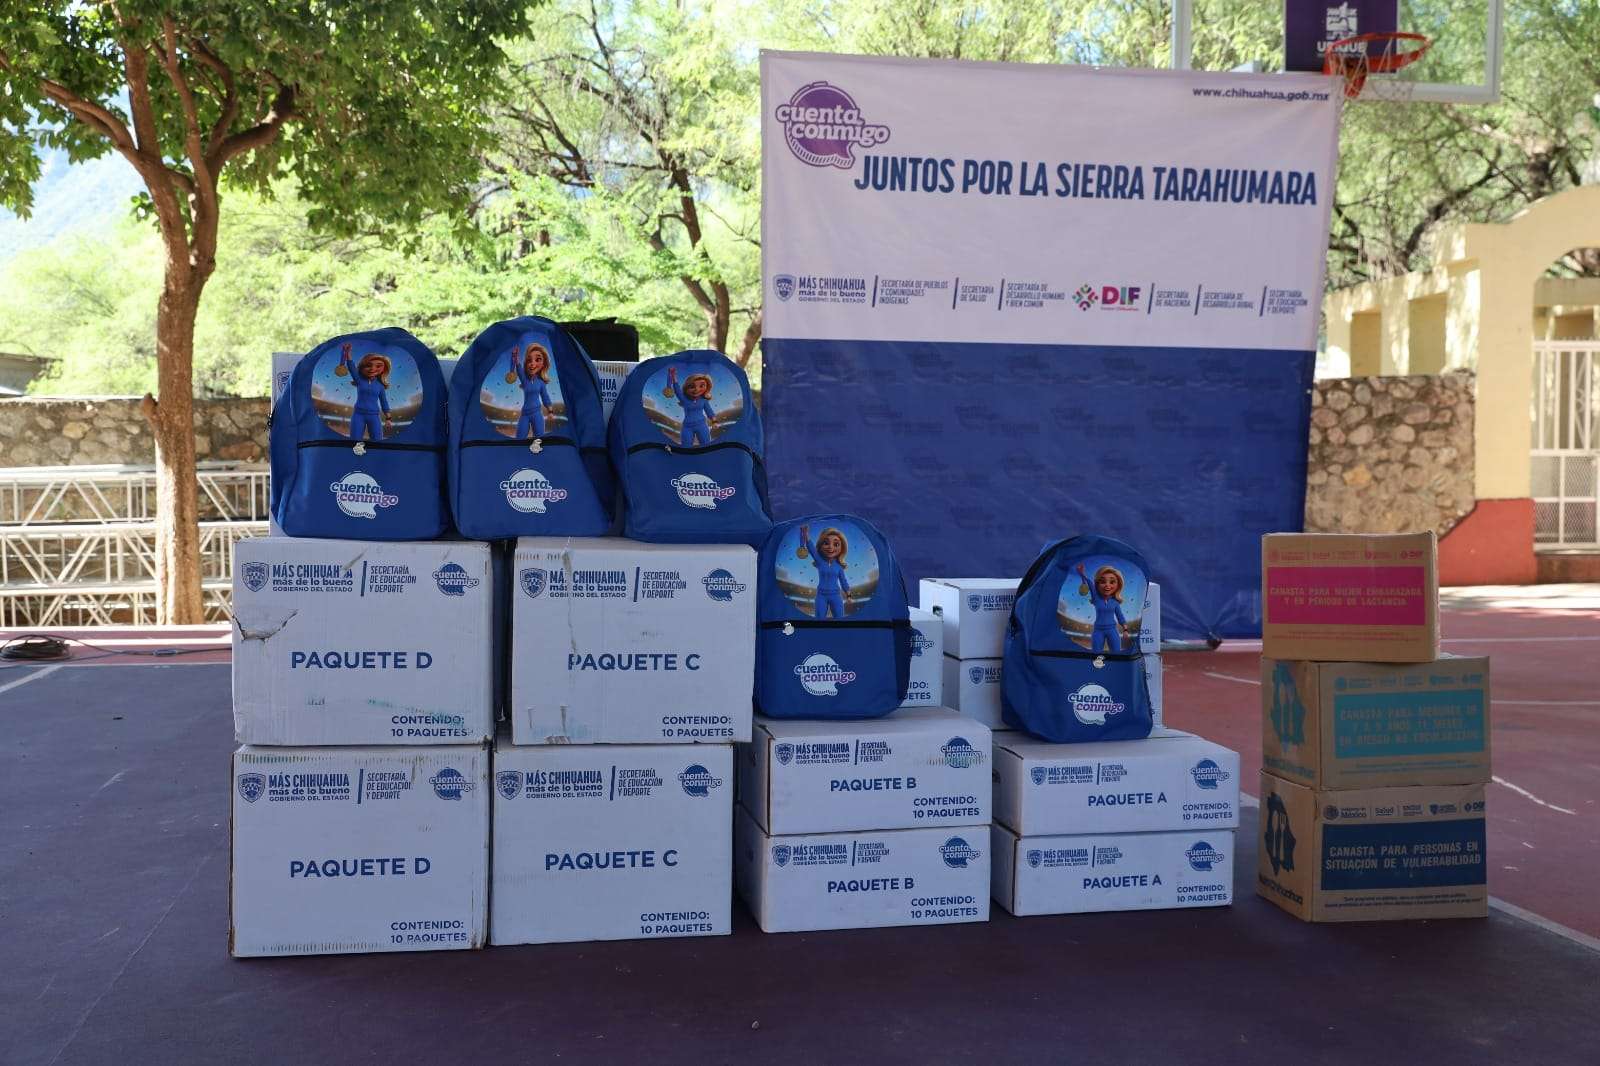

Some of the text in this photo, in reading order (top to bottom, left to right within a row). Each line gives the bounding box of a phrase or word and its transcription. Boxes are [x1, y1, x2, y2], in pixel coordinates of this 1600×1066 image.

[1193, 86, 1330, 102] www.chihuahua.gob.mx
[775, 104, 861, 126] cuenta
[791, 121, 890, 147] conmigo
[854, 155, 1318, 205] JUNTOS POR LA SIERRA TARAHUMARA
[800, 276, 865, 290] MÁS CHIHUAHUA
[914, 280, 923, 288] DE
[799, 289, 816, 297] más
[840, 290, 866, 298] bueno
[970, 294, 986, 302] SALUD
[1102, 287, 1141, 305] DIF
[331, 483, 380, 494] cuenta
[501, 480, 549, 490] cuenta
[671, 479, 718, 489] cuenta
[510, 488, 567, 501] conmigo
[681, 487, 735, 499] conmigo
[339, 493, 398, 506] conmigo
[432, 570, 468, 579] cuenta
[436, 577, 479, 587] conmigo
[701, 576, 736, 586] cuenta
[706, 583, 746, 593] conmigo
[291, 652, 432, 669] PAQUETE D
[568, 654, 700, 670] PAQUETE C
[794, 663, 839, 674] cuenta
[804, 672, 856, 683] conmigo
[1068, 694, 1112, 704] cuenta
[1076, 703, 1124, 714] conmigo
[392, 715, 465, 724] CONTENIDO:
[662, 716, 731, 725] CONTENIDO:
[392, 728, 468, 737] 10 PAQUETES
[662, 728, 733, 737] 10 PAQUETES
[526, 769, 602, 784] MÁS CHIHUAHUA
[619, 768, 656, 779] SECRETARÍA
[678, 771, 710, 781] cuenta
[269, 772, 349, 788] MÁS CHIHUAHUA
[619, 777, 663, 788] DE EDUCACIÓN
[683, 778, 722, 789] conmigo
[831, 777, 916, 792] PAQUETE B
[292, 787, 304, 795] de
[320, 786, 349, 794] bueno
[526, 785, 545, 793] más
[547, 784, 559, 792] de
[618, 787, 651, 796] Y DEPORTE
[913, 796, 977, 806] CONTENIDO:
[1088, 792, 1167, 807] PAQUETE A
[1183, 803, 1231, 811] CONTENIDO:
[913, 808, 979, 818] 10 PAQUETES
[1183, 811, 1232, 820] 10 PAQUETES
[1330, 842, 1478, 857] CANASTA PARA PERSONAS EN
[546, 850, 678, 871] PAQUETE C
[1325, 854, 1481, 871] SITUACIÓN DE VULNERABILIDAD
[291, 858, 431, 878] PAQUETE D
[828, 878, 914, 892] PAQUETE B
[1083, 875, 1162, 889] PAQUETE A
[1177, 885, 1226, 893] CONTENIDO:
[911, 896, 975, 907] CONTENIDO:
[1177, 893, 1227, 903] 10 PAQUETES
[641, 911, 710, 922] CONTENIDO:
[911, 908, 978, 918] 10 PAQUETES
[391, 921, 464, 931] CONTENIDO:
[641, 924, 712, 934] 10 PAQUETES
[391, 933, 467, 943] 10 PAQUETES
